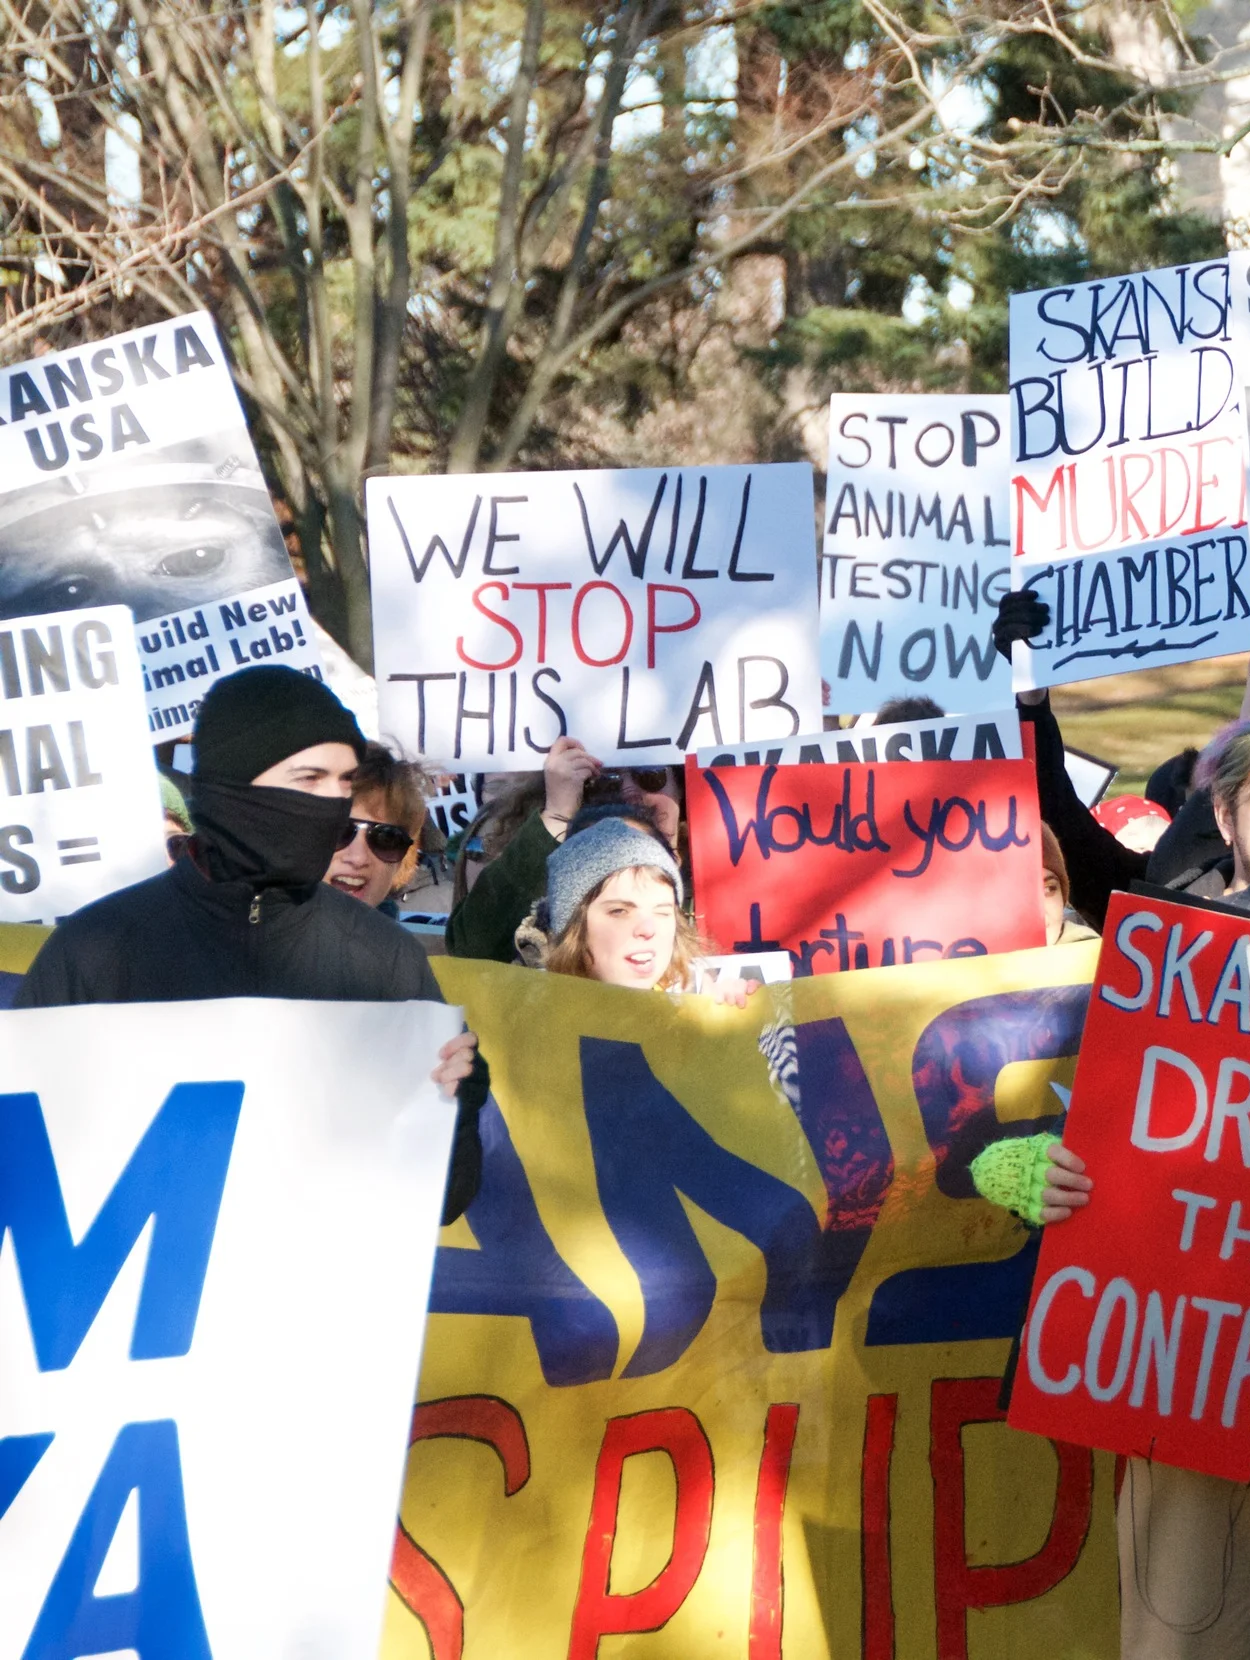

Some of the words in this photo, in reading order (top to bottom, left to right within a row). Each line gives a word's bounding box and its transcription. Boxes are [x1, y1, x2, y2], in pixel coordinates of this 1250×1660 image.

[0, 324, 215, 425] ANSKA
[1010, 346, 1240, 462] BUILD
[24, 403, 151, 472] USA
[837, 409, 1001, 469] STOP
[387, 494, 529, 583] WE
[573, 472, 775, 582] WILL
[827, 482, 1010, 546] ANIMAL
[823, 553, 1011, 613] TESTING
[137, 610, 210, 654] uild
[218, 592, 297, 632] New
[229, 618, 307, 665] Lab!
[456, 580, 701, 671] STOP
[838, 619, 997, 682] NOW
[387, 667, 567, 760] THIS
[616, 656, 800, 752] LAB
[703, 765, 891, 867] Would
[892, 794, 1031, 878] you
